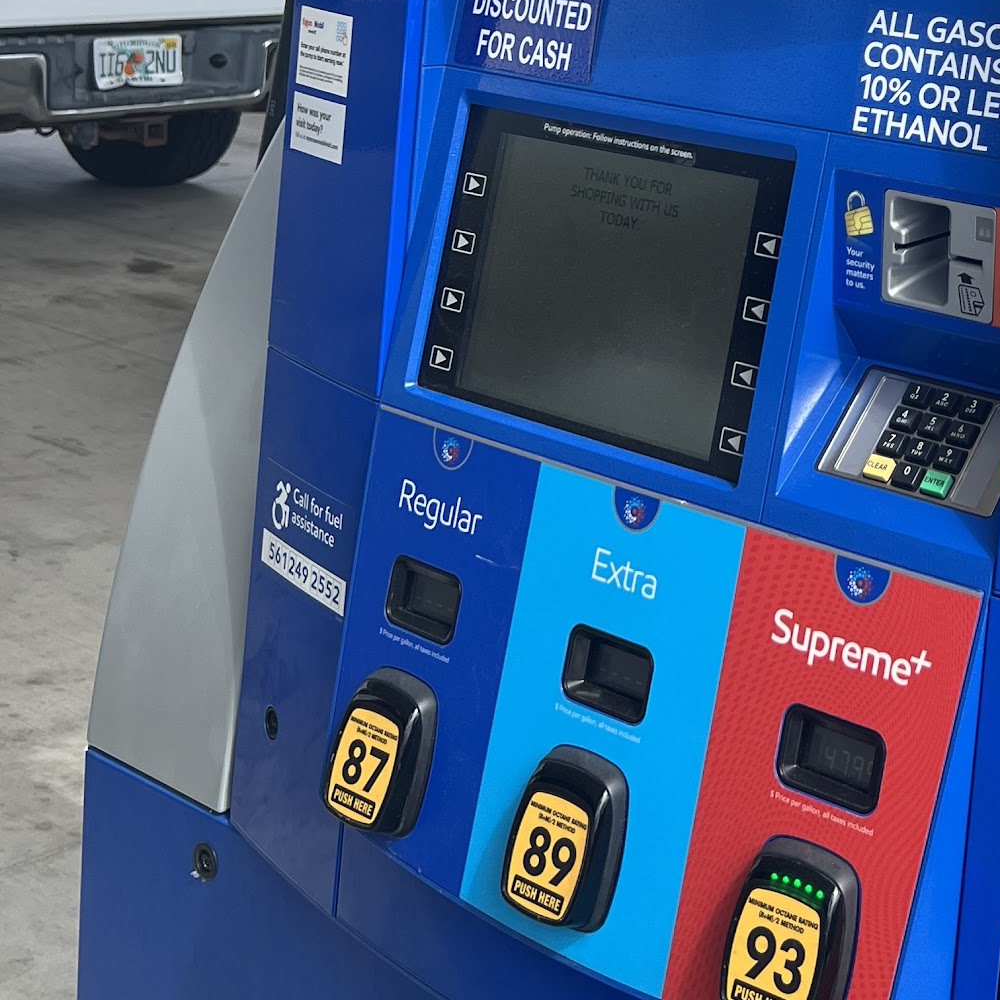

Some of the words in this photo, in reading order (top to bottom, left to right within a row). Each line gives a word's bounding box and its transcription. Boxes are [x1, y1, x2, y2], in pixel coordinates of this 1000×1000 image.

[867, 9, 920, 40] ALL
[476, 28, 516, 62] FOR
[518, 36, 573, 71] CASH
[860, 73, 912, 106] 10%
[918, 82, 961, 113] OR
[543, 122, 562, 135] Pump
[562, 127, 592, 140] operation:
[592, 132, 614, 144] Follow
[614, 136, 650, 150] instructions
[650, 144, 659, 153] on
[659, 145, 670, 155] the
[670, 147, 694, 159] screen.
[852, 105, 988, 152] ETHANOL
[584, 166, 621, 186] THANK
[624, 176, 647, 191] YOU
[650, 180, 673, 196] FOR
[571, 185, 627, 207] SHOPPING
[629, 195, 660, 214] WITH
[663, 204, 680, 218] US
[845, 258, 875, 272] security
[846, 246, 864, 257] Your
[845, 268, 874, 281] matters
[845, 278, 854, 287] to
[854, 281, 866, 290] us.
[866, 460, 889, 471] CLEAR
[923, 475, 945, 487] ENTER
[293, 488, 310, 511] Call
[310, 497, 324, 518] for
[325, 505, 343, 531] fuel
[398, 478, 483, 535] Regular
[291, 511, 335, 548] assistance
[311, 570, 340, 605] 2552
[591, 546, 658, 600] Extra
[342, 739, 390, 793] 87
[333, 788, 353, 807] PUSH
[353, 798, 374, 817] HERE
[523, 826, 577, 887] 89
[514, 880, 537, 900] PUSH
[537, 891, 562, 912] HERE
[745, 926, 805, 995] 93
